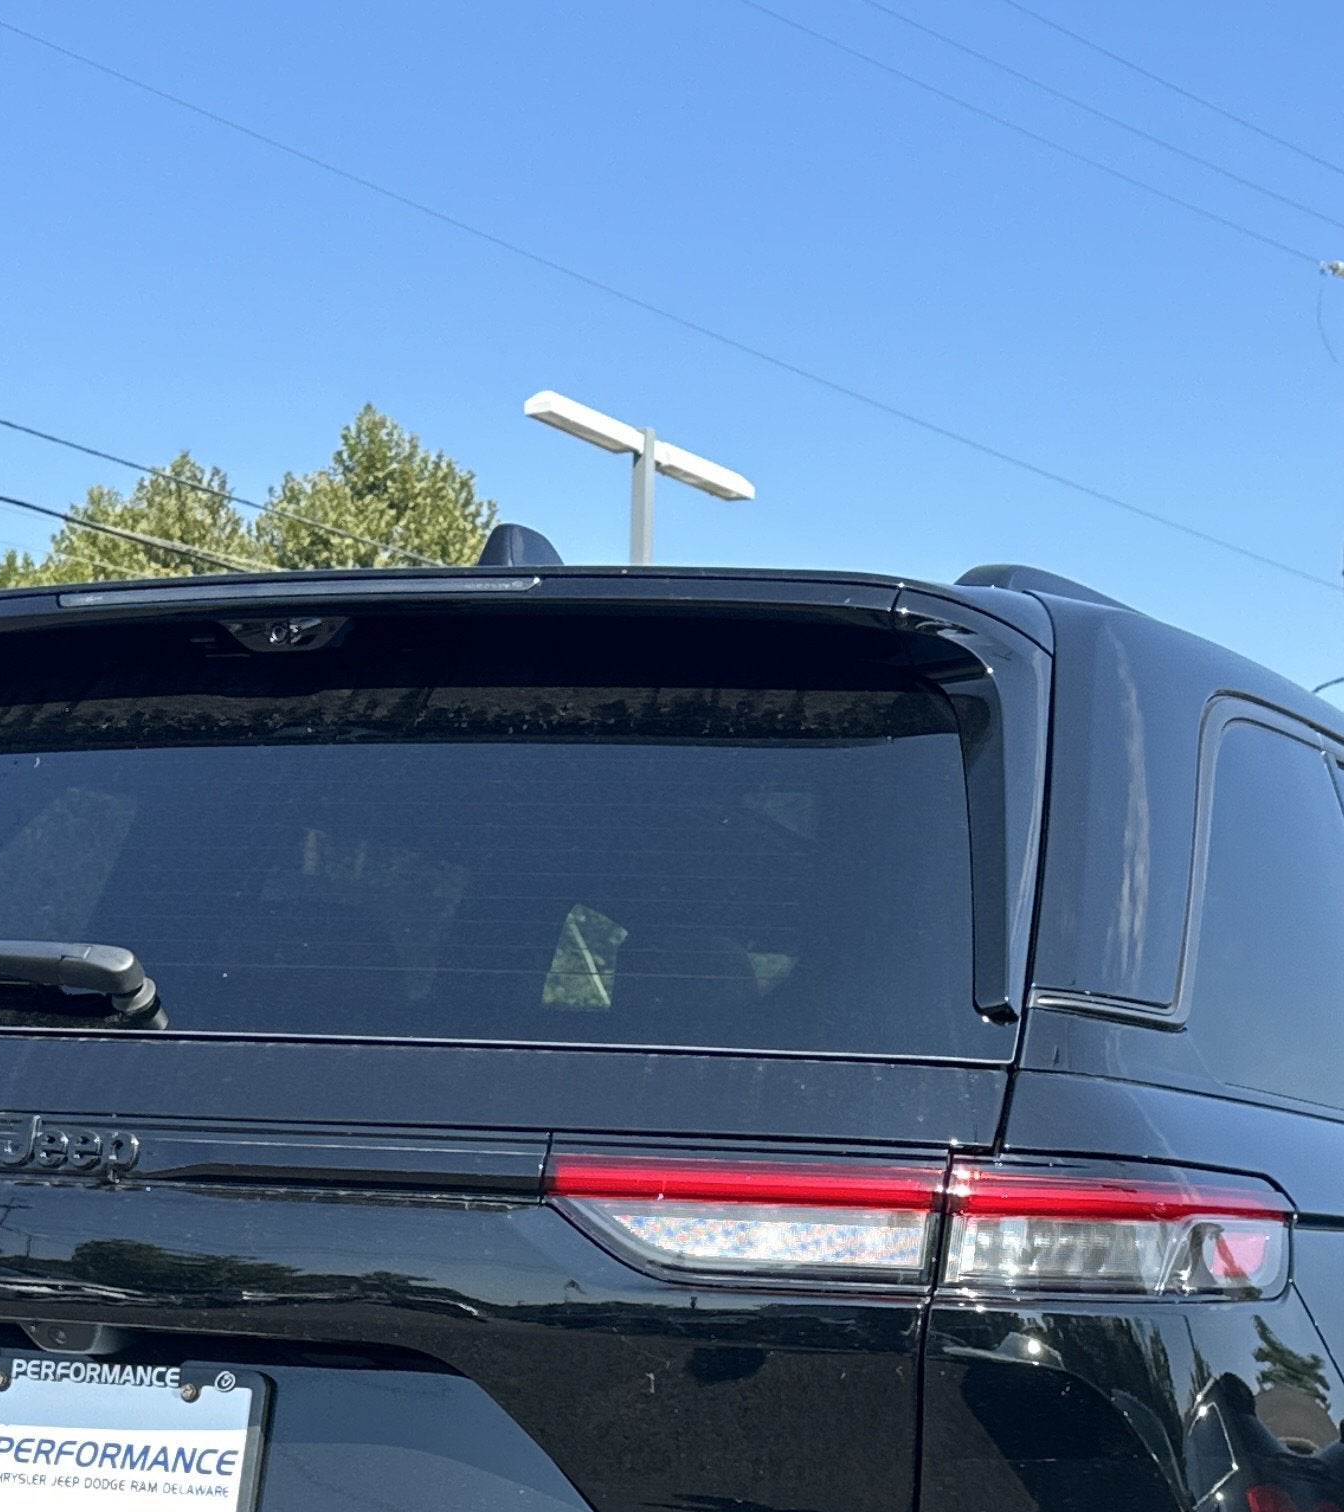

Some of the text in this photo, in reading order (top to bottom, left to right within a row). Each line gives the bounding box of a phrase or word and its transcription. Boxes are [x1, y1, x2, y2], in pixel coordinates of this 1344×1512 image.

[11, 1358, 182, 1388] PERFORMANCE
[51, 1475, 80, 1488] JEEP
[84, 1477, 126, 1491] DODGE
[130, 1480, 158, 1494] RAM
[162, 1482, 230, 1498] DELAWARE
